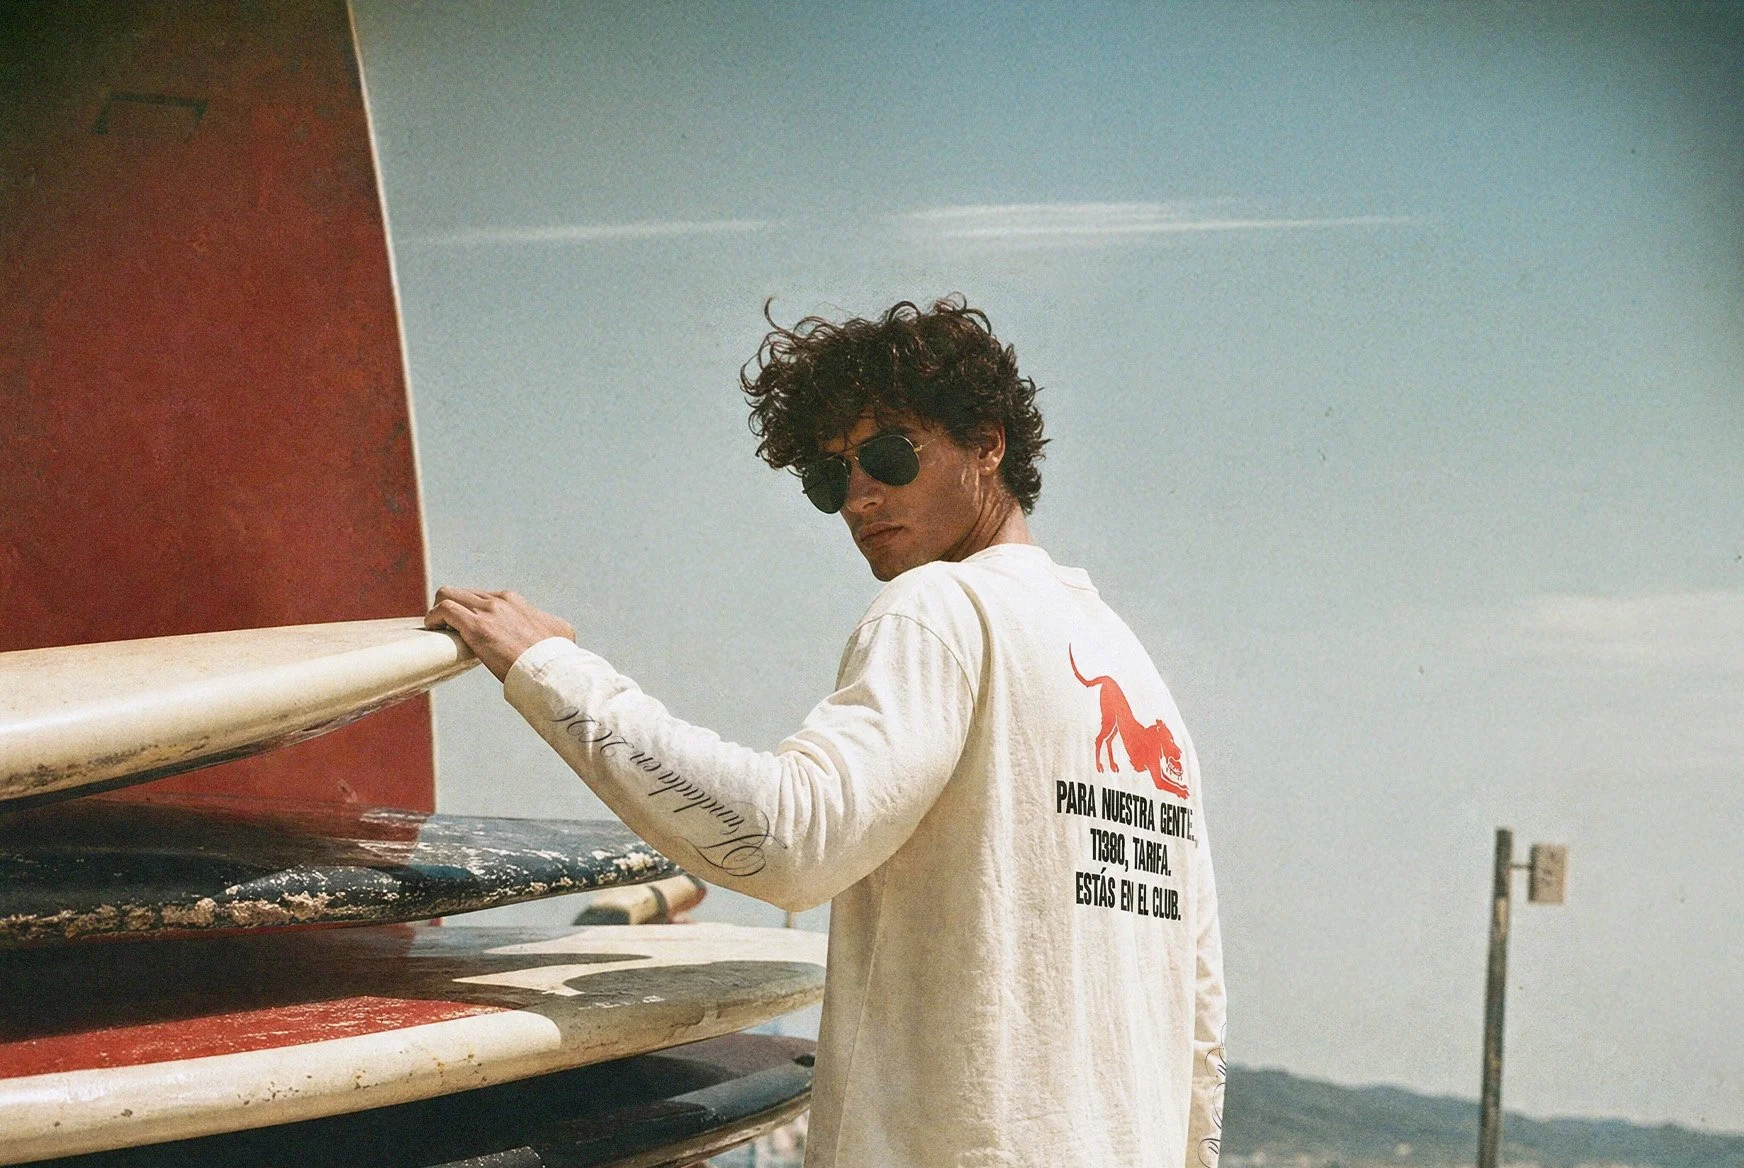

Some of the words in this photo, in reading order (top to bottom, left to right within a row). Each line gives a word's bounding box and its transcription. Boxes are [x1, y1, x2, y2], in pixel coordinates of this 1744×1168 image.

[629, 751, 661, 772] en
[647, 771, 788, 877] Fundada
[1056, 780, 1097, 818] PARA
[1103, 787, 1156, 832] NUESTRA
[1090, 827, 1129, 872] 11380,
[1133, 836, 1172, 877] TARIFA.
[1076, 866, 1116, 909] ESTÁS
[1121, 878, 1135, 914] EN
[1138, 883, 1149, 916] EL
[1152, 886, 1182, 921] CLUB.
